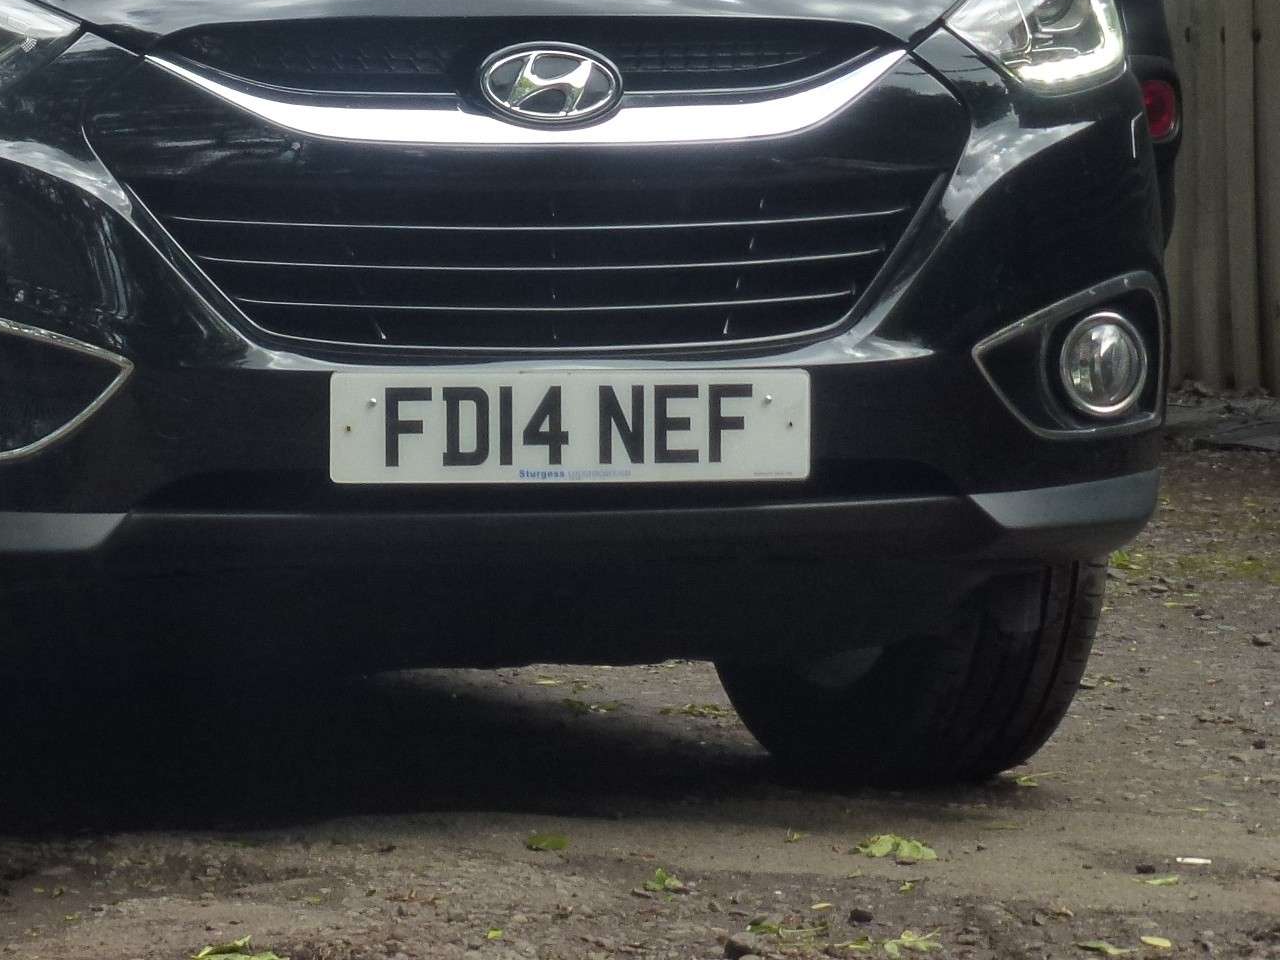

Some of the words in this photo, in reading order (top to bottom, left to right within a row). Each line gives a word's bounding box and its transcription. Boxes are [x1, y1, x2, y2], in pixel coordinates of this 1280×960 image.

[385, 385, 569, 467] FD14
[598, 383, 753, 464] NEF
[519, 469, 565, 479] Sturgess
